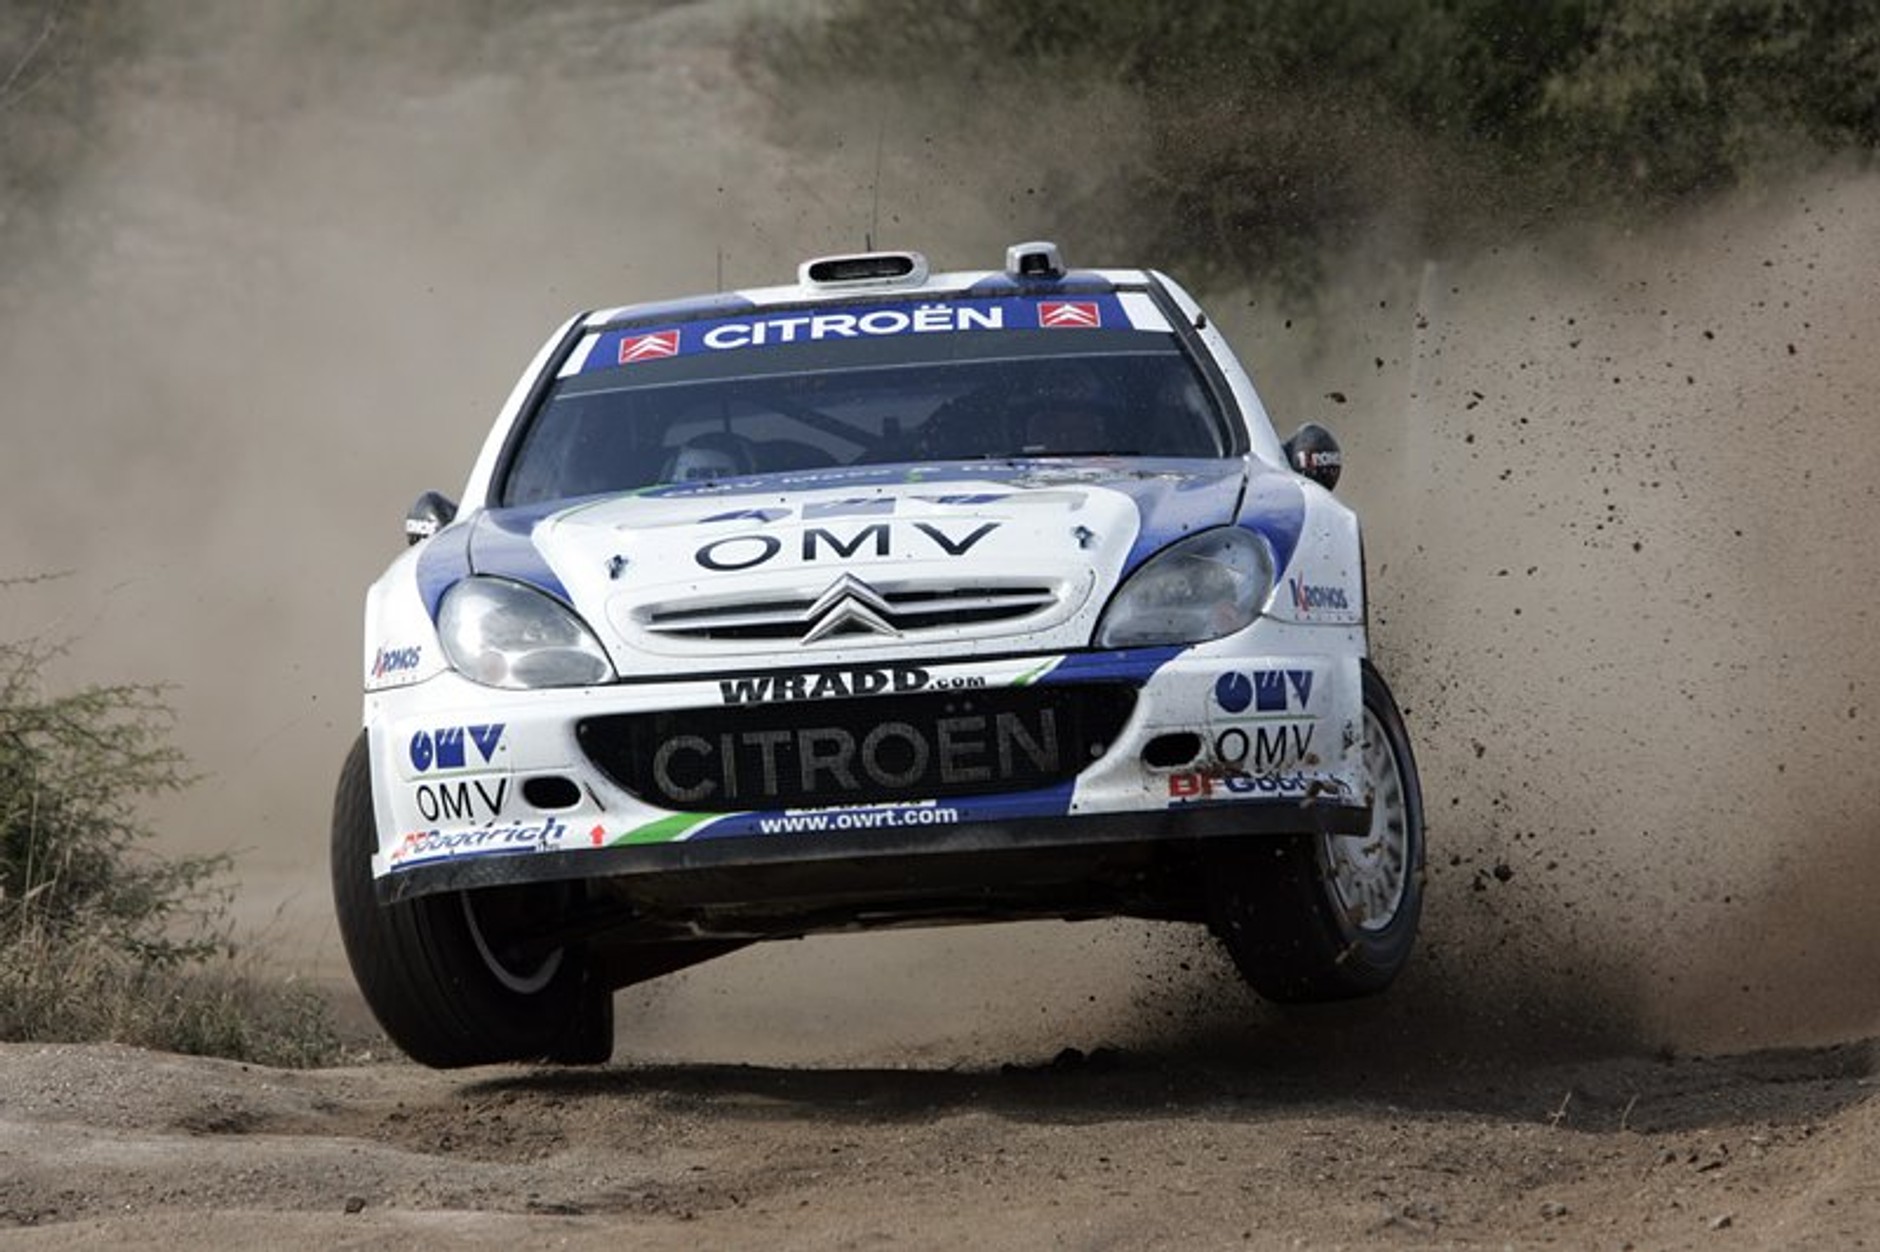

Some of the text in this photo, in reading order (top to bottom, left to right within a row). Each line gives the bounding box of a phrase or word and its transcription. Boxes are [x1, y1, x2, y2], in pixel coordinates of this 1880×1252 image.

[703, 304, 1003, 350] CITROËN
[695, 522, 1000, 571] OMV
[719, 664, 986, 704] WRADD.com
[653, 702, 1060, 801] CITROËN
[1215, 723, 1315, 765] OMV
[416, 778, 507, 822] OMV
[760, 808, 959, 835] www.owrt.com
